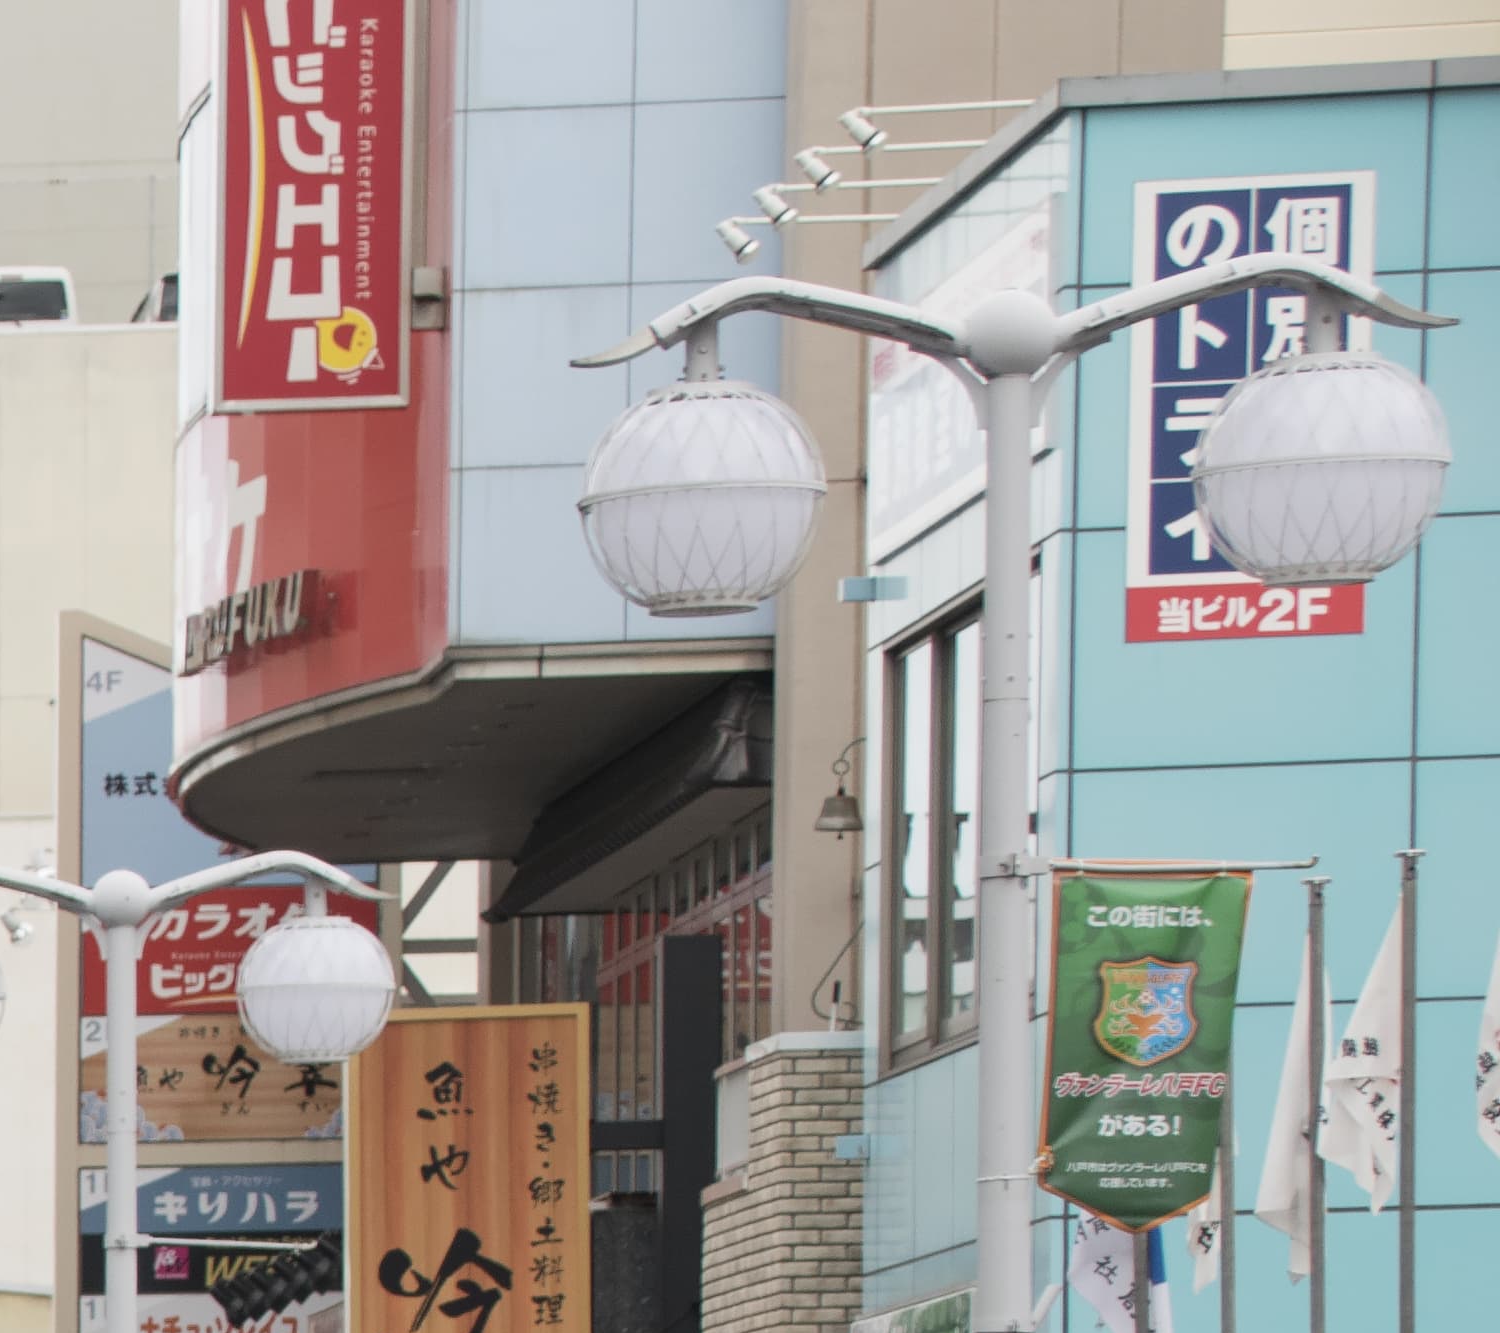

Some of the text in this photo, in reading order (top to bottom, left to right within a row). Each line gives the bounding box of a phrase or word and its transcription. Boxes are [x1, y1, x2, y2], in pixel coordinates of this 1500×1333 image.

[354, 18, 379, 300] Karaoke Entertainment
[1157, 587, 1332, 635] 当ビル2F
[86, 669, 123, 692] 4F
[104, 772, 169, 798] 株式
[1087, 905, 1214, 929] この街には、
[528, 1041, 567, 1326] 串焼き・郷土料理
